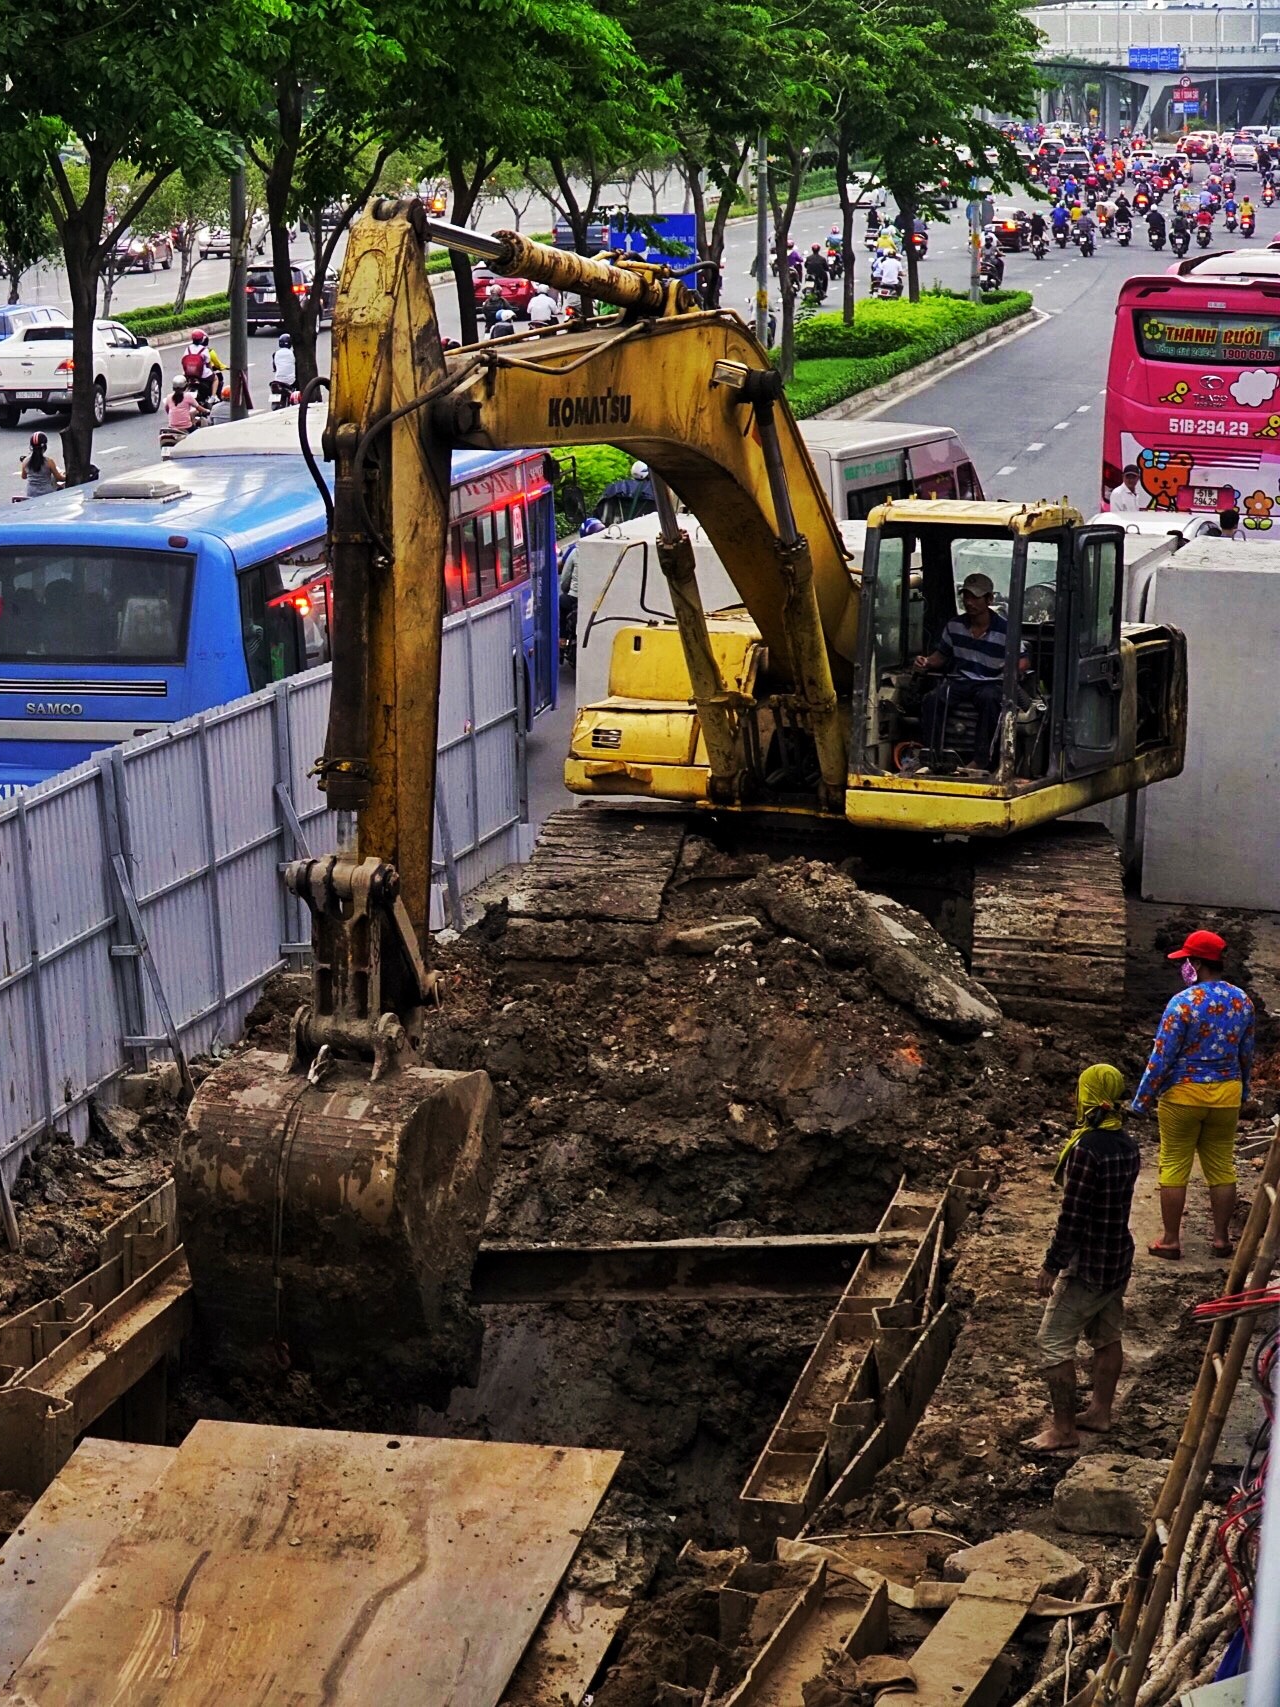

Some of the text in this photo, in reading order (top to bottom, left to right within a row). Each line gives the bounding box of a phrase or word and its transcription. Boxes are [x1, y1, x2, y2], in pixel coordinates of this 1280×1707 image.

[1166, 323, 1262, 346] THÀNH BƯỞI
[1223, 349, 1247, 360] 1900
[1249, 350, 1275, 361] 6079
[548, 387, 632, 428] KOMATSU
[26, 702, 83, 715] SAMCO
